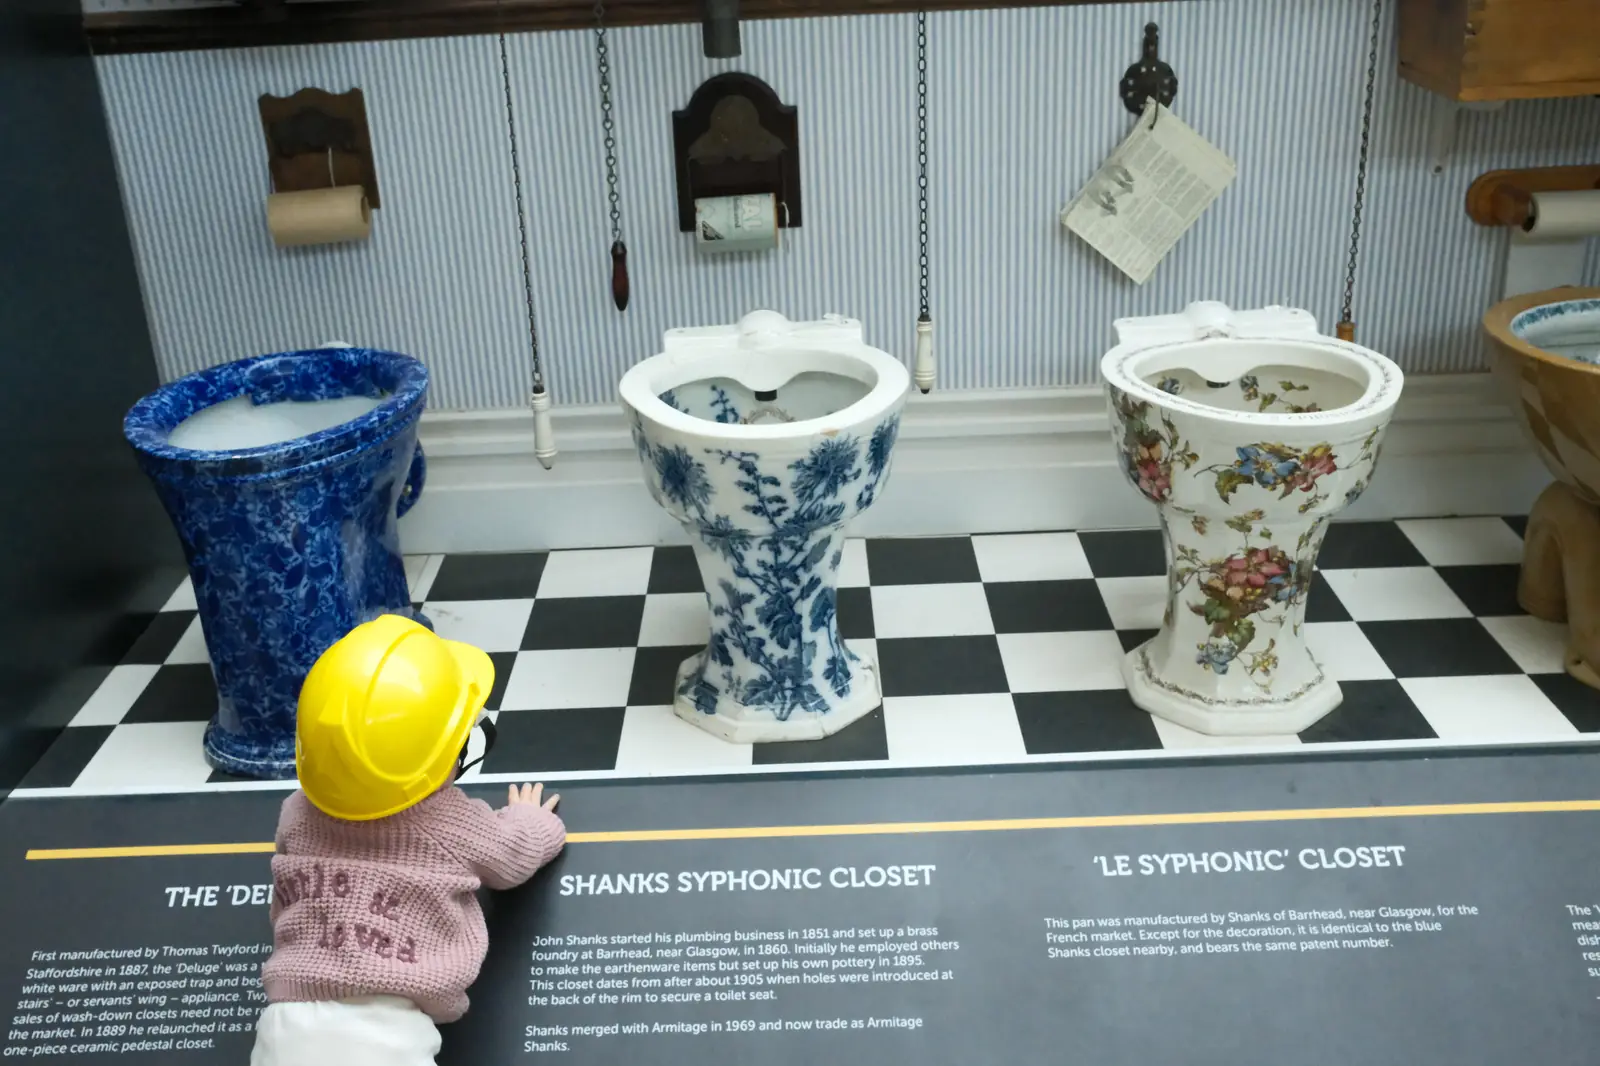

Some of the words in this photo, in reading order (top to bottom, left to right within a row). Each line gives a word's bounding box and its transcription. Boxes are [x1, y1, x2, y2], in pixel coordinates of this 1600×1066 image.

[1299, 846, 1405, 869] CLOSET
[560, 873, 669, 895] SHANKS
[678, 868, 821, 892] SYPHONIC
[830, 865, 936, 888] CLOSET
[165, 886, 220, 907] THE
[1044, 918, 1069, 928] This
[1072, 919, 1095, 929] pan
[1097, 918, 1121, 926] was
[1124, 913, 1208, 926] manufactured
[1210, 913, 1225, 925] by
[1228, 912, 1271, 922] Shanks
[1273, 910, 1286, 921] of
[1288, 908, 1346, 920] Barrhead,
[1349, 910, 1376, 918] near
[1379, 906, 1435, 919] Glasgow,
[1437, 905, 1454, 916] for
[1457, 905, 1478, 915] the
[1565, 904, 1592, 916] The
[532, 936, 563, 946] John
[566, 934, 608, 945] Shanks
[610, 933, 652, 944] started
[655, 932, 672, 943] his
[675, 931, 731, 944] plumbing
[735, 931, 784, 941] business
[788, 929, 799, 939] in
[802, 928, 830, 939] 1851
[832, 928, 855, 938] and
[858, 928, 876, 938] set
[879, 929, 894, 939] up
[897, 928, 904, 937] a
[907, 926, 938, 936] brass
[1046, 932, 1088, 943] French
[1091, 931, 1136, 941] market.
[1139, 930, 1180, 941] Except
[1183, 928, 1200, 938] for
[1203, 928, 1223, 938] the
[1226, 926, 1295, 937] decoration,
[1298, 925, 1306, 934] it
[1309, 924, 1319, 934] is
[1321, 923, 1373, 934] identical
[1375, 923, 1389, 932] to
[1392, 922, 1412, 932] the
[1414, 921, 1442, 931] blue
[31, 951, 56, 961] First
[59, 947, 143, 960] manufactured
[162, 946, 208, 956] Thomas
[212, 944, 259, 957] Twyford
[532, 950, 579, 962] foundry
[581, 950, 593, 960] at
[597, 948, 652, 959] Barrhead,
[656, 949, 683, 957] near
[686, 946, 740, 958] Glasgow,
[744, 945, 755, 955] in
[758, 944, 790, 955] 1860.
[795, 943, 837, 955] Initially
[840, 942, 855, 952] he
[858, 941, 919, 956] employed
[921, 940, 960, 951] others
[1048, 947, 1091, 958] Shanks
[1093, 946, 1130, 956] closet
[1133, 944, 1177, 956] nearby,
[1181, 943, 1203, 953] and
[1206, 943, 1239, 953] bears
[1242, 942, 1262, 951] the
[1265, 942, 1297, 951] same
[1300, 939, 1339, 951] patent
[1342, 937, 1393, 948] number.
[26, 967, 102, 979] Staffordshire
[119, 964, 148, 975] 1887,
[153, 964, 172, 974] the
[225, 964, 248, 972] was
[531, 966, 543, 976] to
[547, 965, 579, 975] make
[582, 964, 601, 974] the
[605, 962, 680, 973] earthenware
[683, 961, 716, 971] items
[719, 960, 739, 971] but
[743, 960, 760, 970] set
[763, 961, 779, 972] up
[782, 959, 799, 969] his
[802, 960, 828, 968] own
[832, 958, 875, 970] pottery
[879, 956, 890, 966] in
[893, 955, 925, 966] 1895.
[22, 983, 55, 994] white
[59, 984, 88, 992] ware
[91, 981, 117, 991] with
[137, 978, 187, 991] exposed
[190, 978, 214, 989] trap
[216, 976, 239, 987] and
[529, 980, 554, 990] This
[557, 979, 593, 990] closet
[596, 978, 628, 989] dates
[632, 977, 661, 988] from
[664, 976, 692, 987] after
[695, 976, 731, 986] about
[734, 974, 763, 985] 1905
[766, 971, 800, 984] when
[803, 973, 836, 983] holes
[839, 974, 869, 982] were
[871, 970, 939, 981] introduced
[941, 970, 953, 980] at
[138, 994, 167, 1006] wing
[181, 992, 241, 1007] appliance.
[528, 995, 548, 1006] the
[551, 994, 580, 1005] back
[583, 993, 596, 1004] of
[599, 993, 618, 1004] the
[622, 993, 642, 1003] rim
[645, 993, 658, 1002] to
[661, 993, 702, 1002] secure
[704, 993, 711, 1001] a
[715, 990, 746, 1001] toilet
[749, 990, 777, 1000] seat.
[12, 1013, 43, 1025] sales
[62, 1011, 132, 1022] wash-down
[136, 1009, 177, 1020] closets
[180, 1007, 211, 1018] need
[213, 1007, 234, 1017] not
[8, 1029, 29, 1040] the
[31, 1028, 76, 1039] market.
[96, 1025, 126, 1036] 1889
[147, 1022, 216, 1034] relaunched
[525, 1025, 568, 1036] Shanks
[572, 1023, 619, 1037] merged
[622, 1023, 649, 1034] with
[652, 1022, 707, 1035] Armitage
[711, 1021, 722, 1032] in
[726, 1020, 756, 1031] 1969
[759, 1019, 782, 1031] and
[785, 1021, 813, 1030] now
[815, 1018, 848, 1029] trade
[851, 1020, 864, 1028] as
[867, 1017, 923, 1030] Armitage
[3, 1044, 67, 1057] one-piece
[70, 1041, 119, 1053] ceramic
[121, 1039, 173, 1053] pedestal
[176, 1038, 215, 1049] closet.
[524, 1040, 570, 1052] Shanks.
